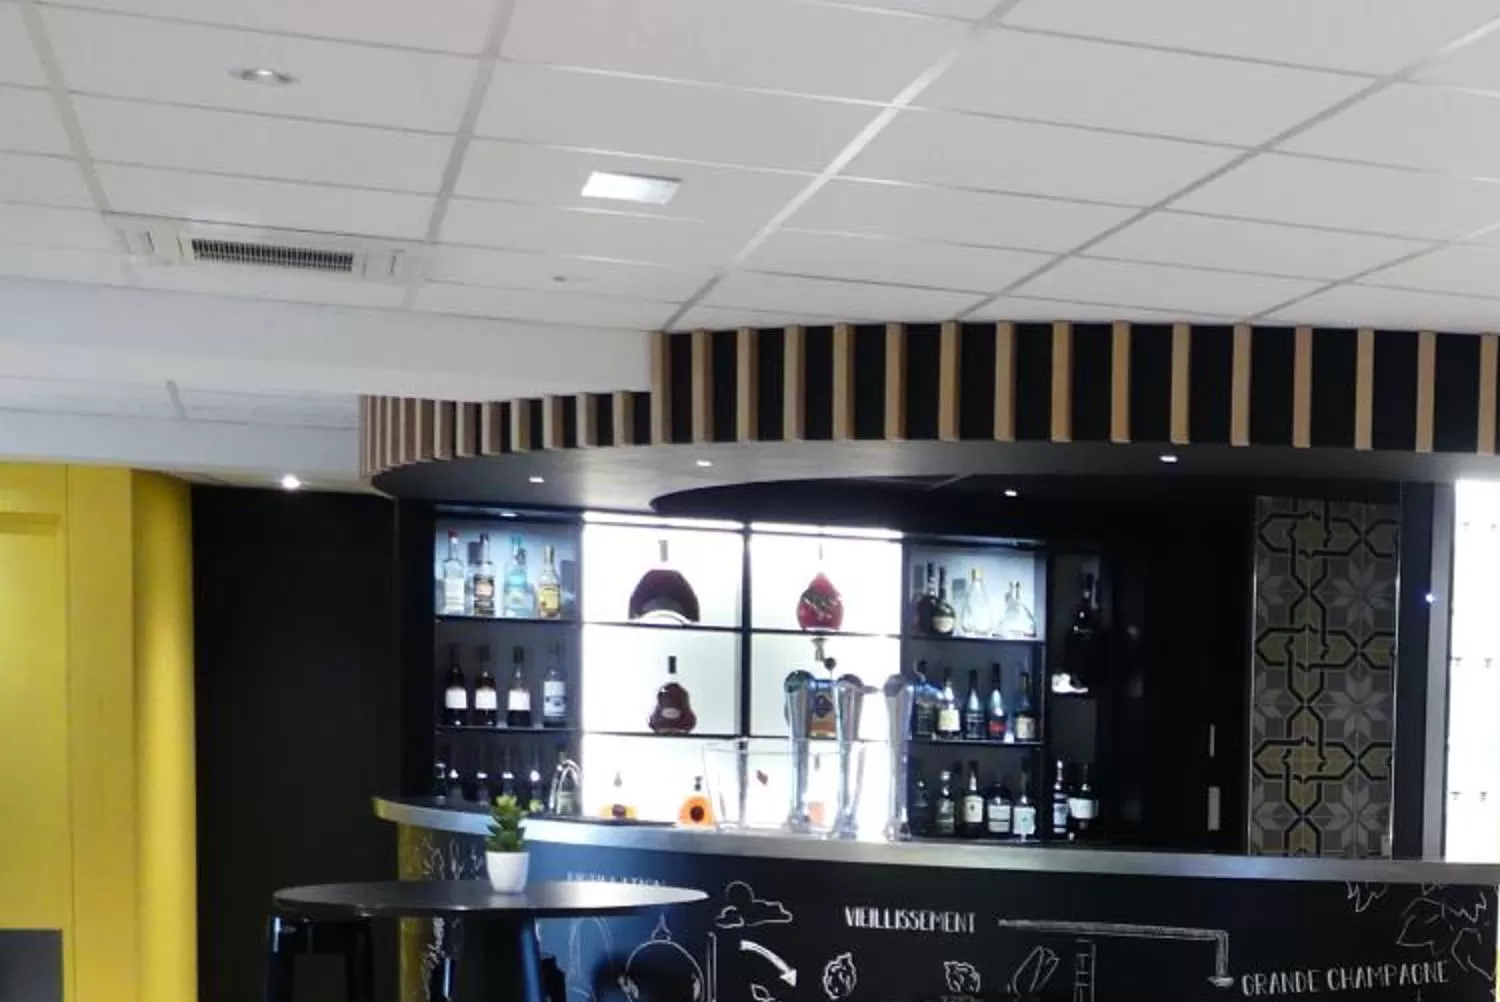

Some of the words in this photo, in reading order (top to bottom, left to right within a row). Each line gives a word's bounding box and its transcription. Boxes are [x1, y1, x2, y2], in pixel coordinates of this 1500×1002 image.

[844, 904, 975, 934] VIEILLISSEMENT
[1241, 969, 1321, 997] GRANDE
[1327, 960, 1449, 990] CHAMPAGNE
